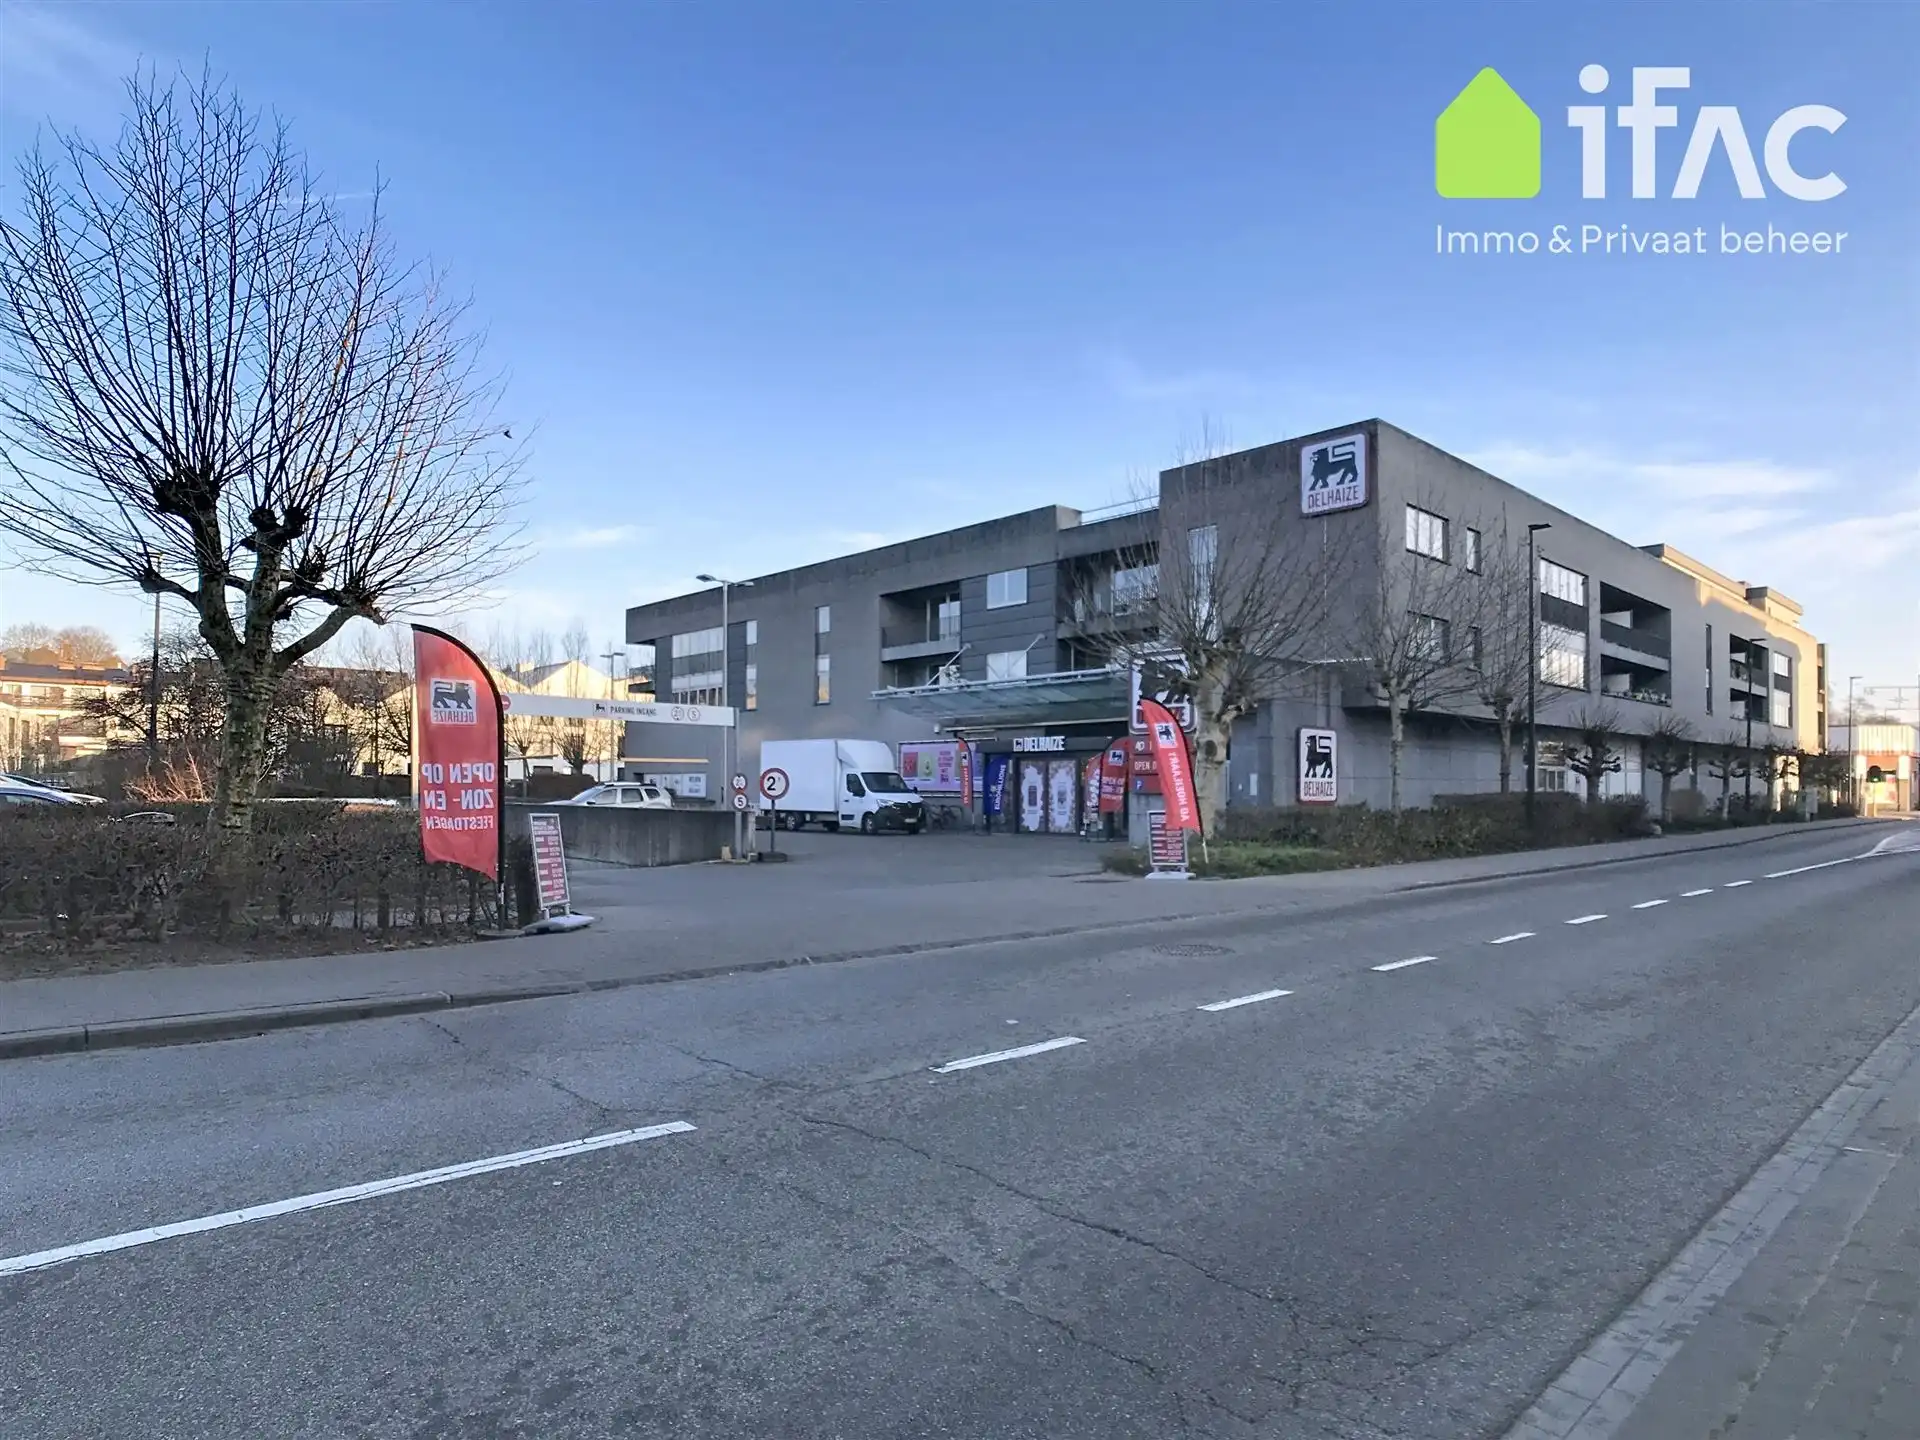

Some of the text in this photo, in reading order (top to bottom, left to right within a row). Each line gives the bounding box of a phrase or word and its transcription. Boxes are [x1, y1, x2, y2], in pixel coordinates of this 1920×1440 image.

[1308, 486, 1358, 509] DELHAIZE
[1024, 736, 1065, 751] DELHAIZE
[1135, 761, 1150, 770] OPEN
[1304, 781, 1333, 796] DELHAIZE
[738, 797, 744, 806] 5
